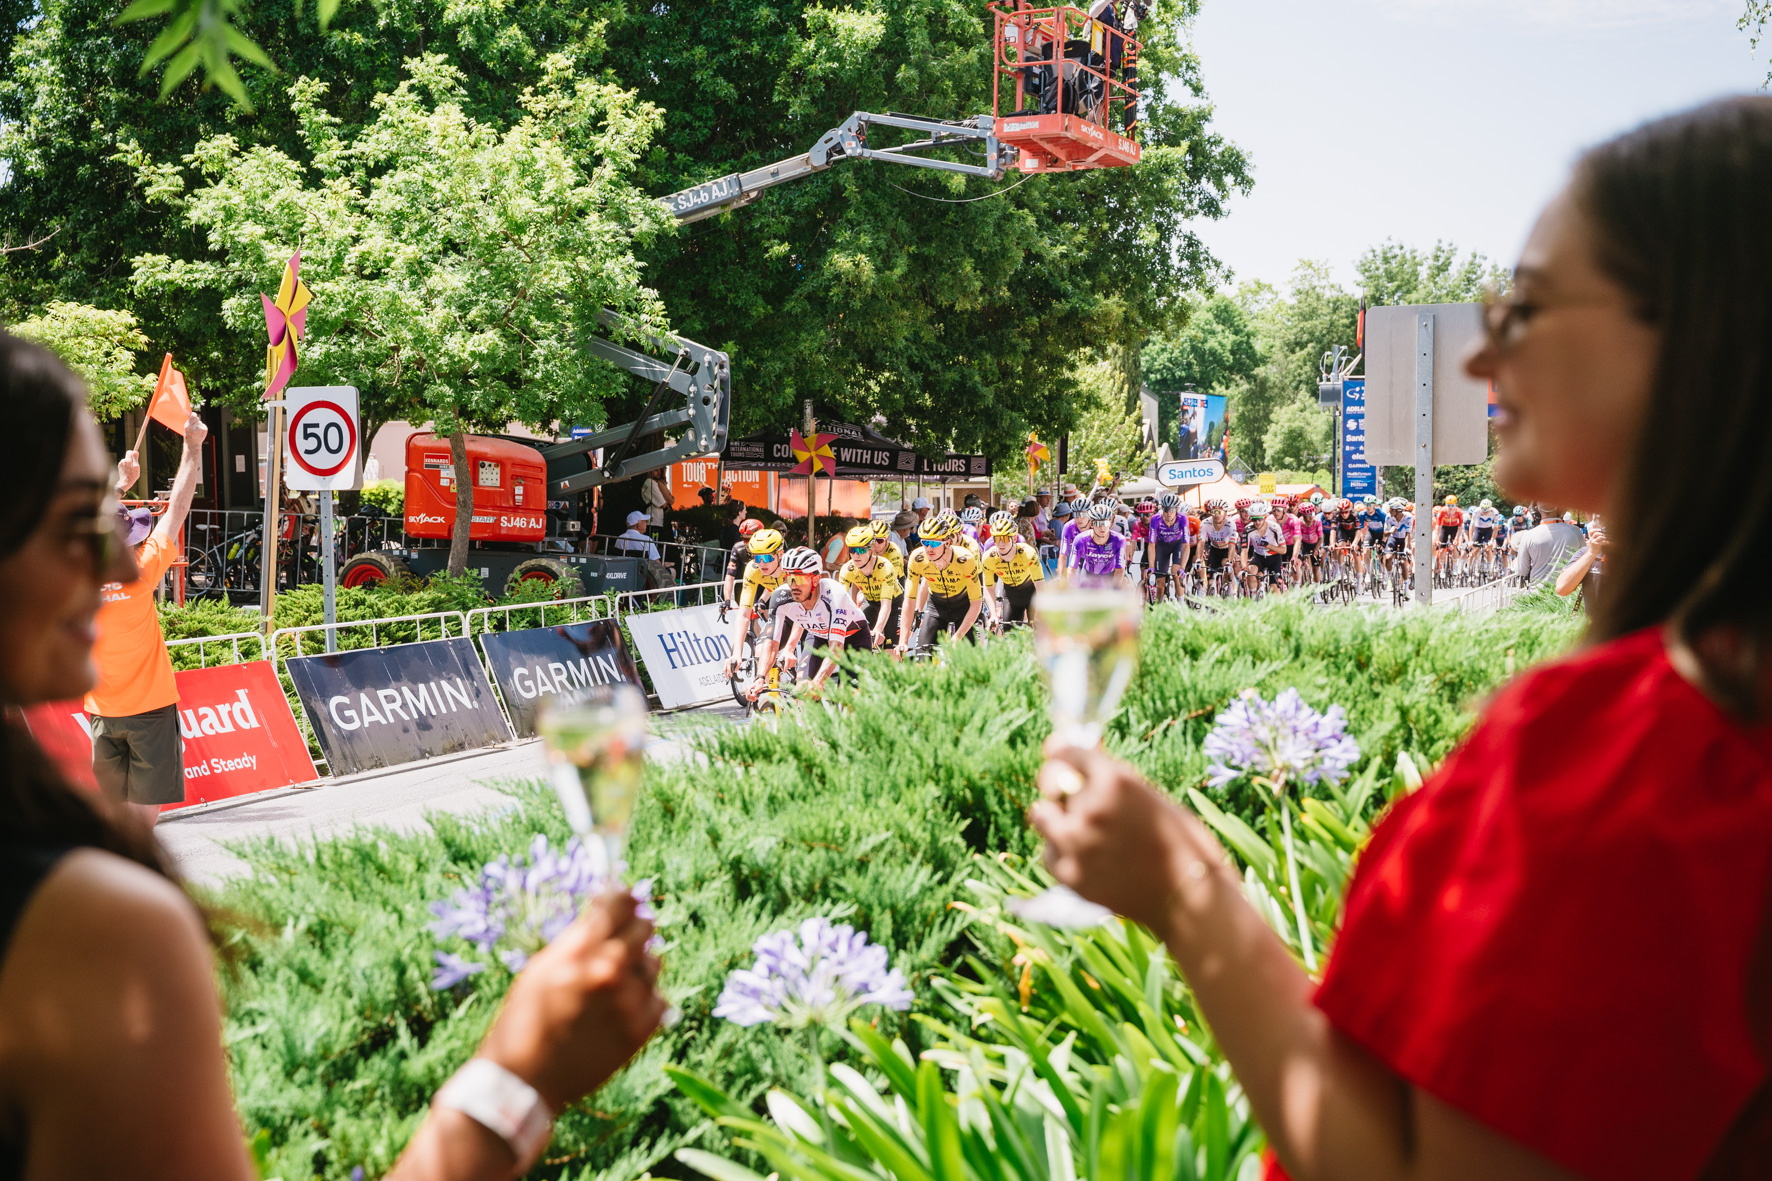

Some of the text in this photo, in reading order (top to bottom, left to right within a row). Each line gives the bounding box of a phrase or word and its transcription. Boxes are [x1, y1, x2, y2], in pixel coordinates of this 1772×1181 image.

[711, 181, 728, 200] AJ
[302, 422, 344, 455] 50
[840, 447, 872, 464] WITH
[873, 450, 890, 466] US
[681, 462, 707, 482] TOUR
[1168, 467, 1215, 480] Santos
[408, 512, 446, 524] SKYJACK
[500, 516, 543, 529] SJ46 AJ
[1086, 551, 1115, 559] Jayco
[657, 630, 733, 669] Hilton
[513, 653, 623, 700] GARMIN
[329, 677, 474, 731] GARMIN
[184, 752, 257, 779] and Steady
